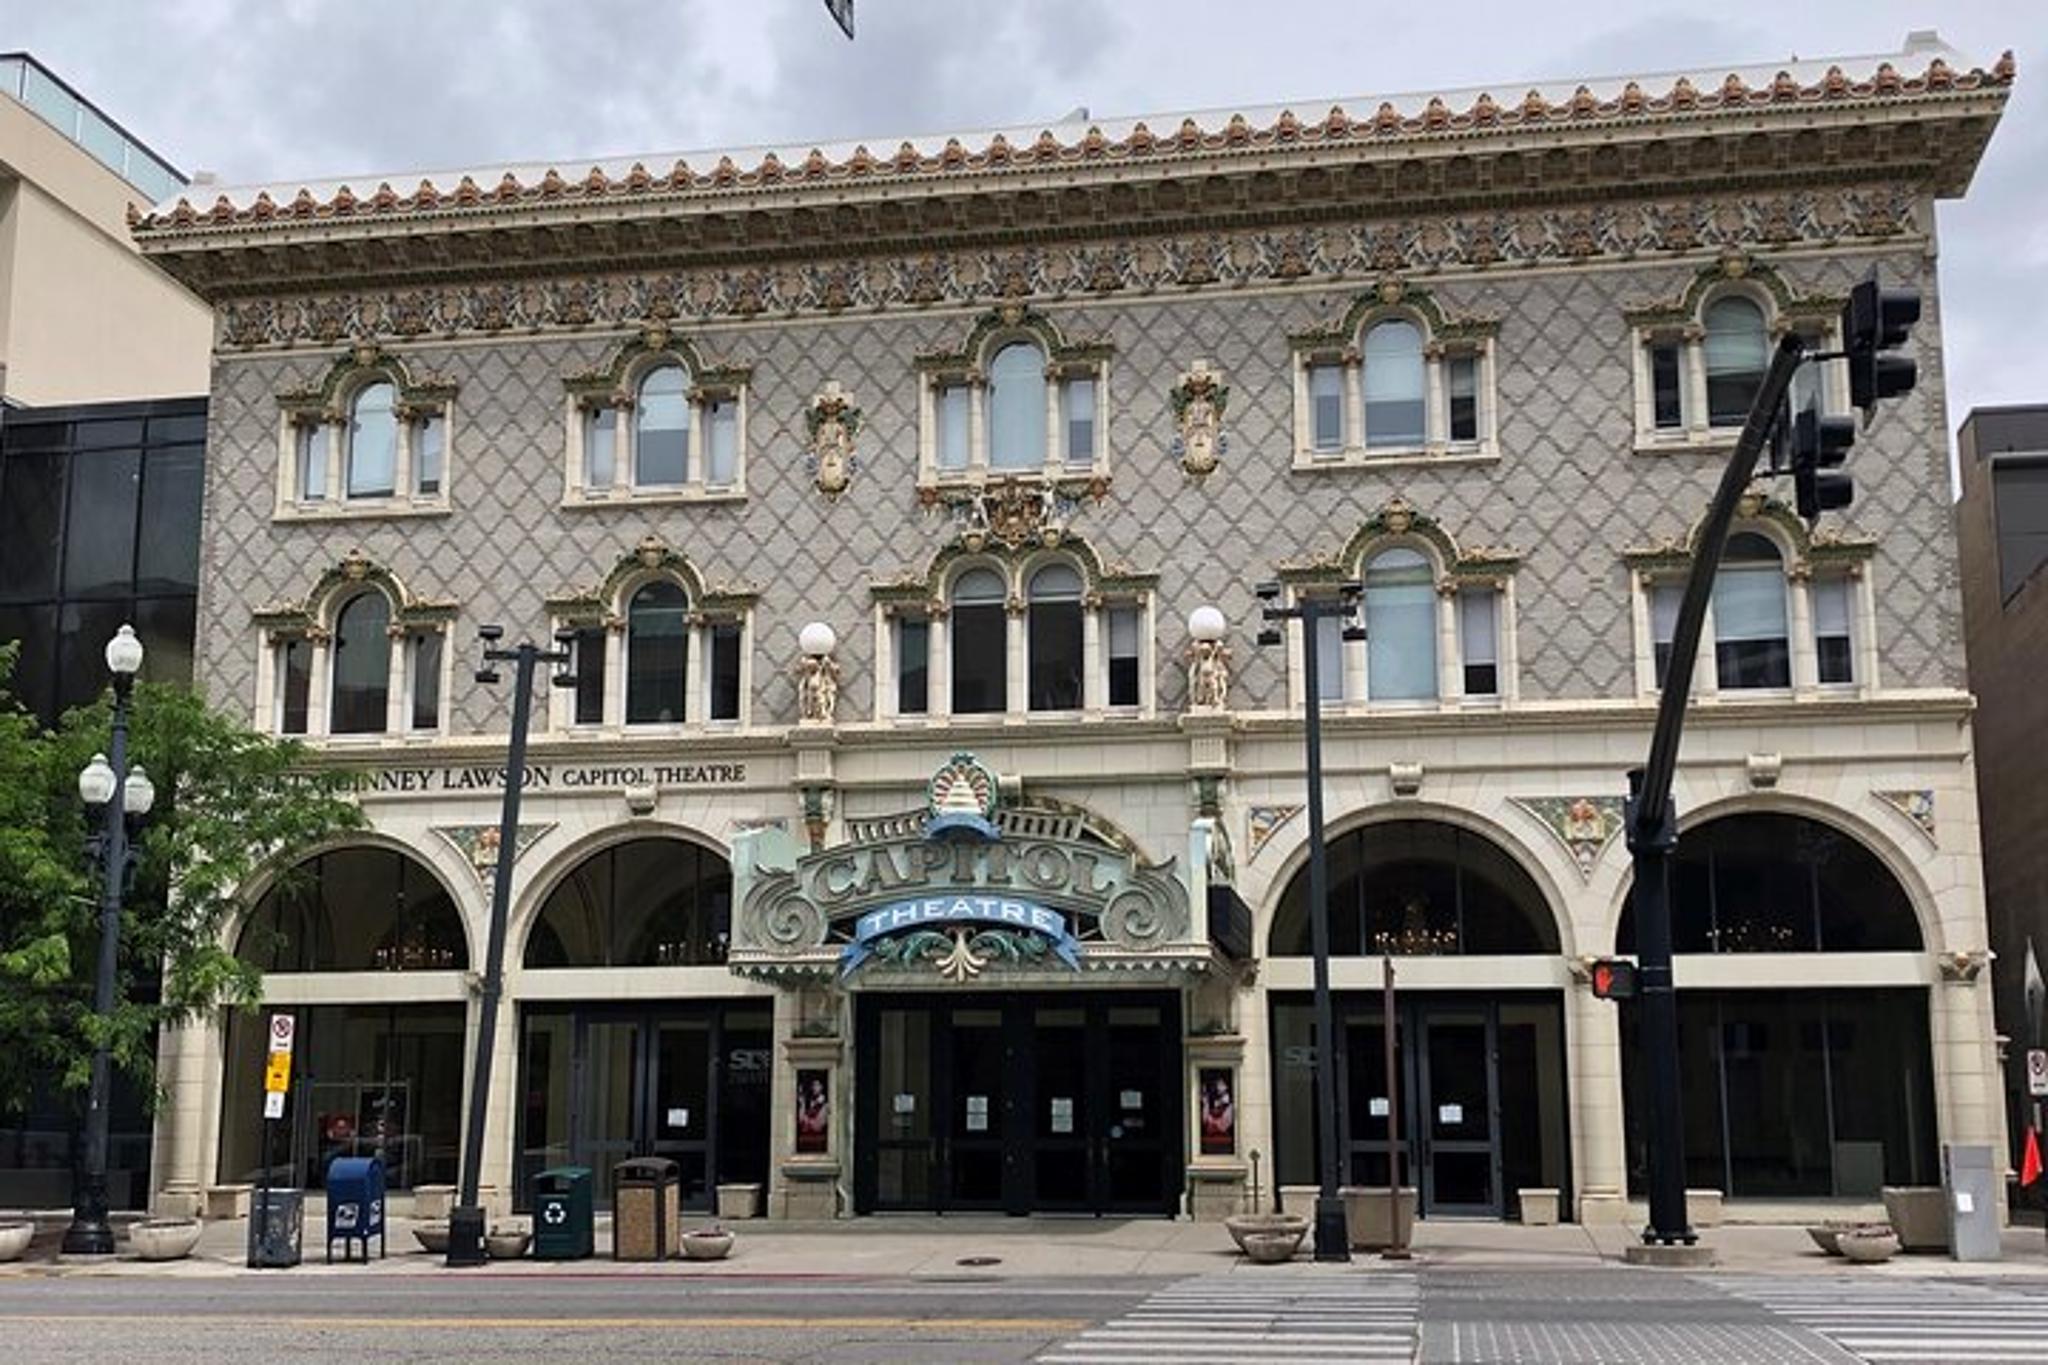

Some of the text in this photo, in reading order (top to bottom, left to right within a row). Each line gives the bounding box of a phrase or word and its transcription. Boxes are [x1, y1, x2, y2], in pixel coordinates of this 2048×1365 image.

[562, 768, 650, 785] CAPITOL
[654, 764, 746, 783] THEATRE
[815, 841, 1114, 900] CAPITOL
[866, 900, 1053, 931] THEATRE
